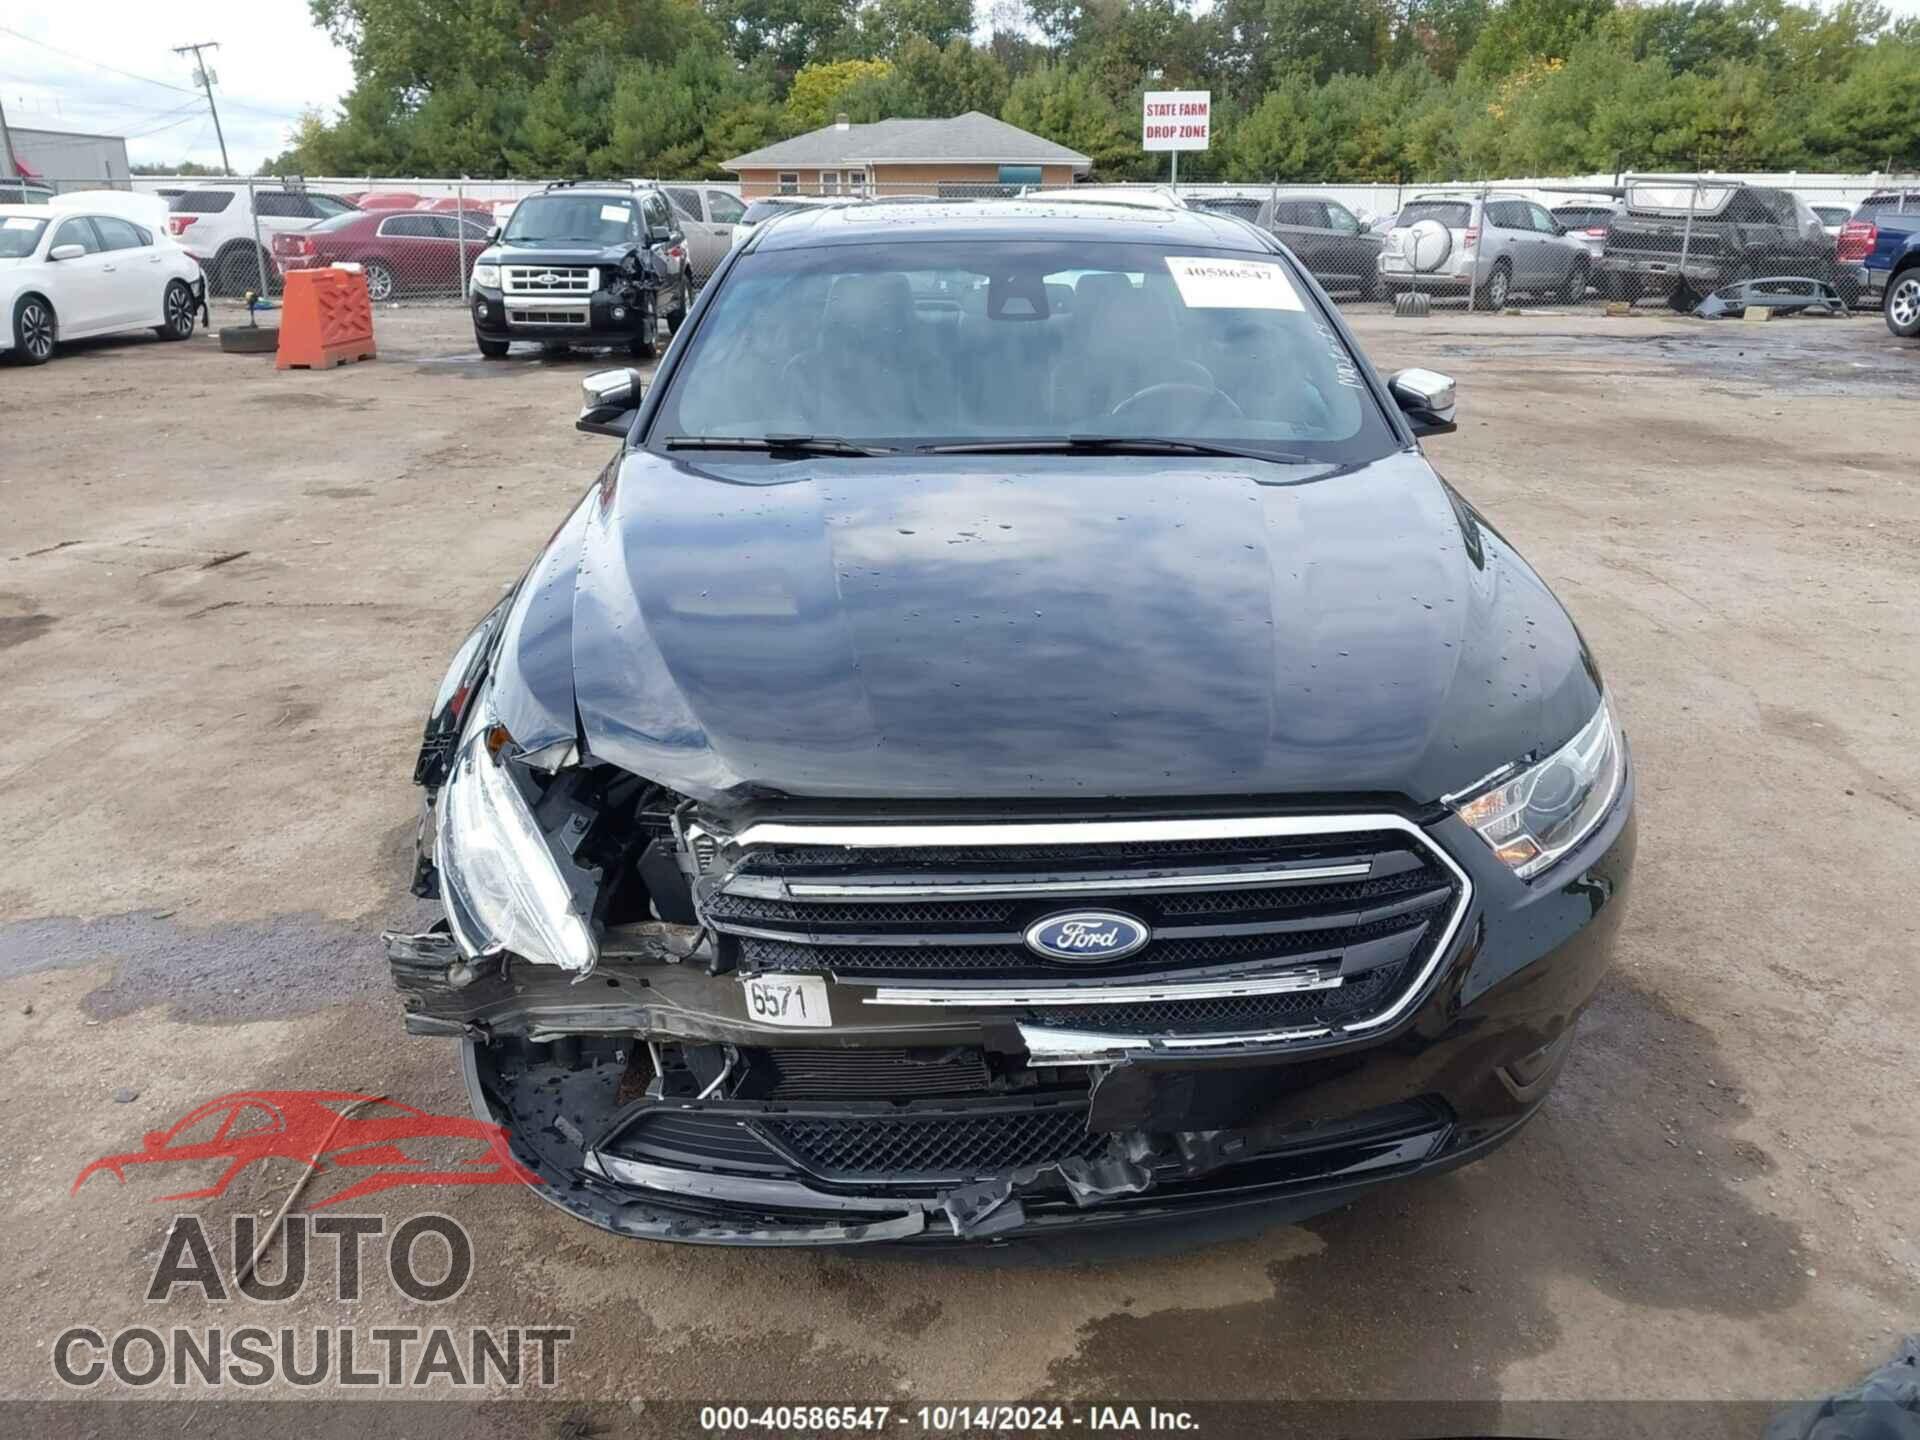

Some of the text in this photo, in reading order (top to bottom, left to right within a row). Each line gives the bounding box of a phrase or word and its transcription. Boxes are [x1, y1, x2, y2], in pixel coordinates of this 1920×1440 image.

[1146, 103, 1208, 117] STATE FARM
[1146, 125, 1207, 139] DROP ZONE
[1183, 266, 1273, 281] 40586547
[1056, 921, 1119, 949] Ford
[750, 982, 808, 1019] 6571
